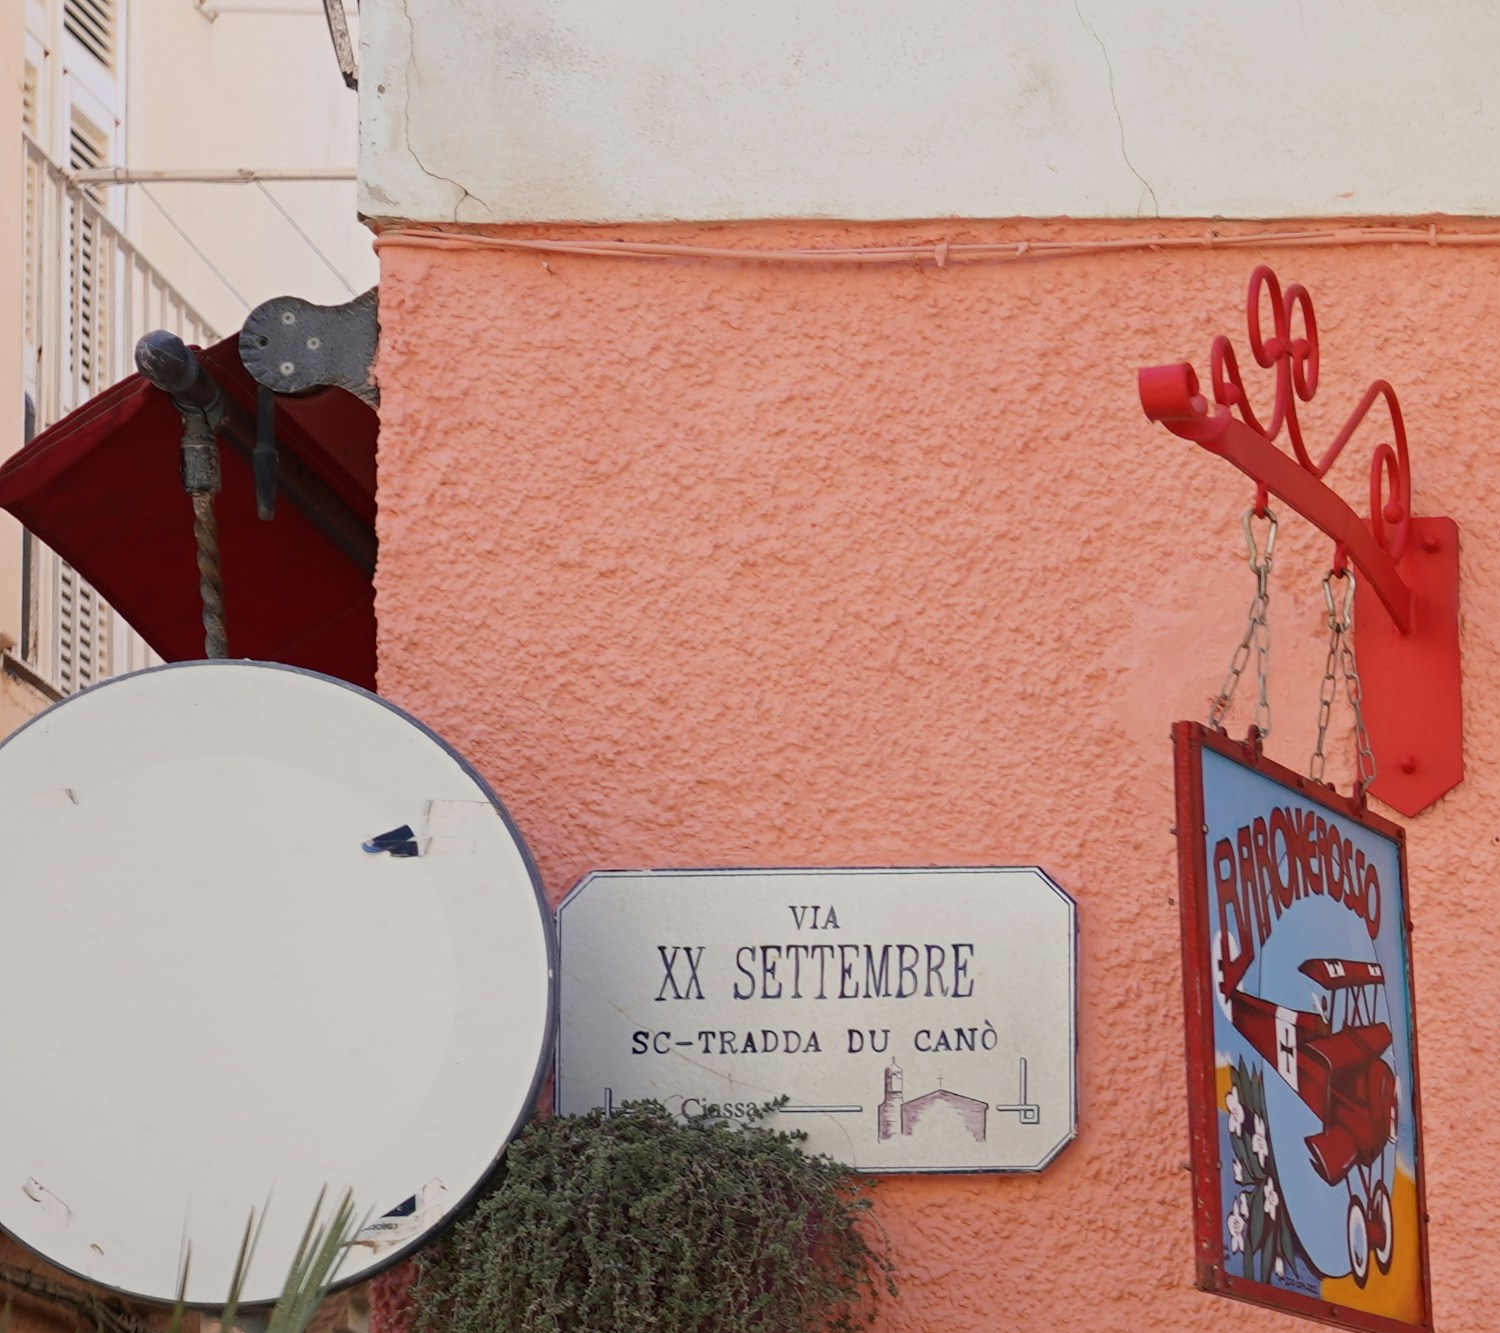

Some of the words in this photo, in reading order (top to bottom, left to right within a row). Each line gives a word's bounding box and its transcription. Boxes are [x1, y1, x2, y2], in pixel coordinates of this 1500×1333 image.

[788, 905, 841, 930] VIA
[654, 945, 706, 1002] XX
[733, 943, 975, 1000] SETTEMBRE
[631, 1029, 821, 1055] SC-TRADDA
[847, 1029, 891, 1054] DU
[914, 1019, 998, 1052] CANÒ
